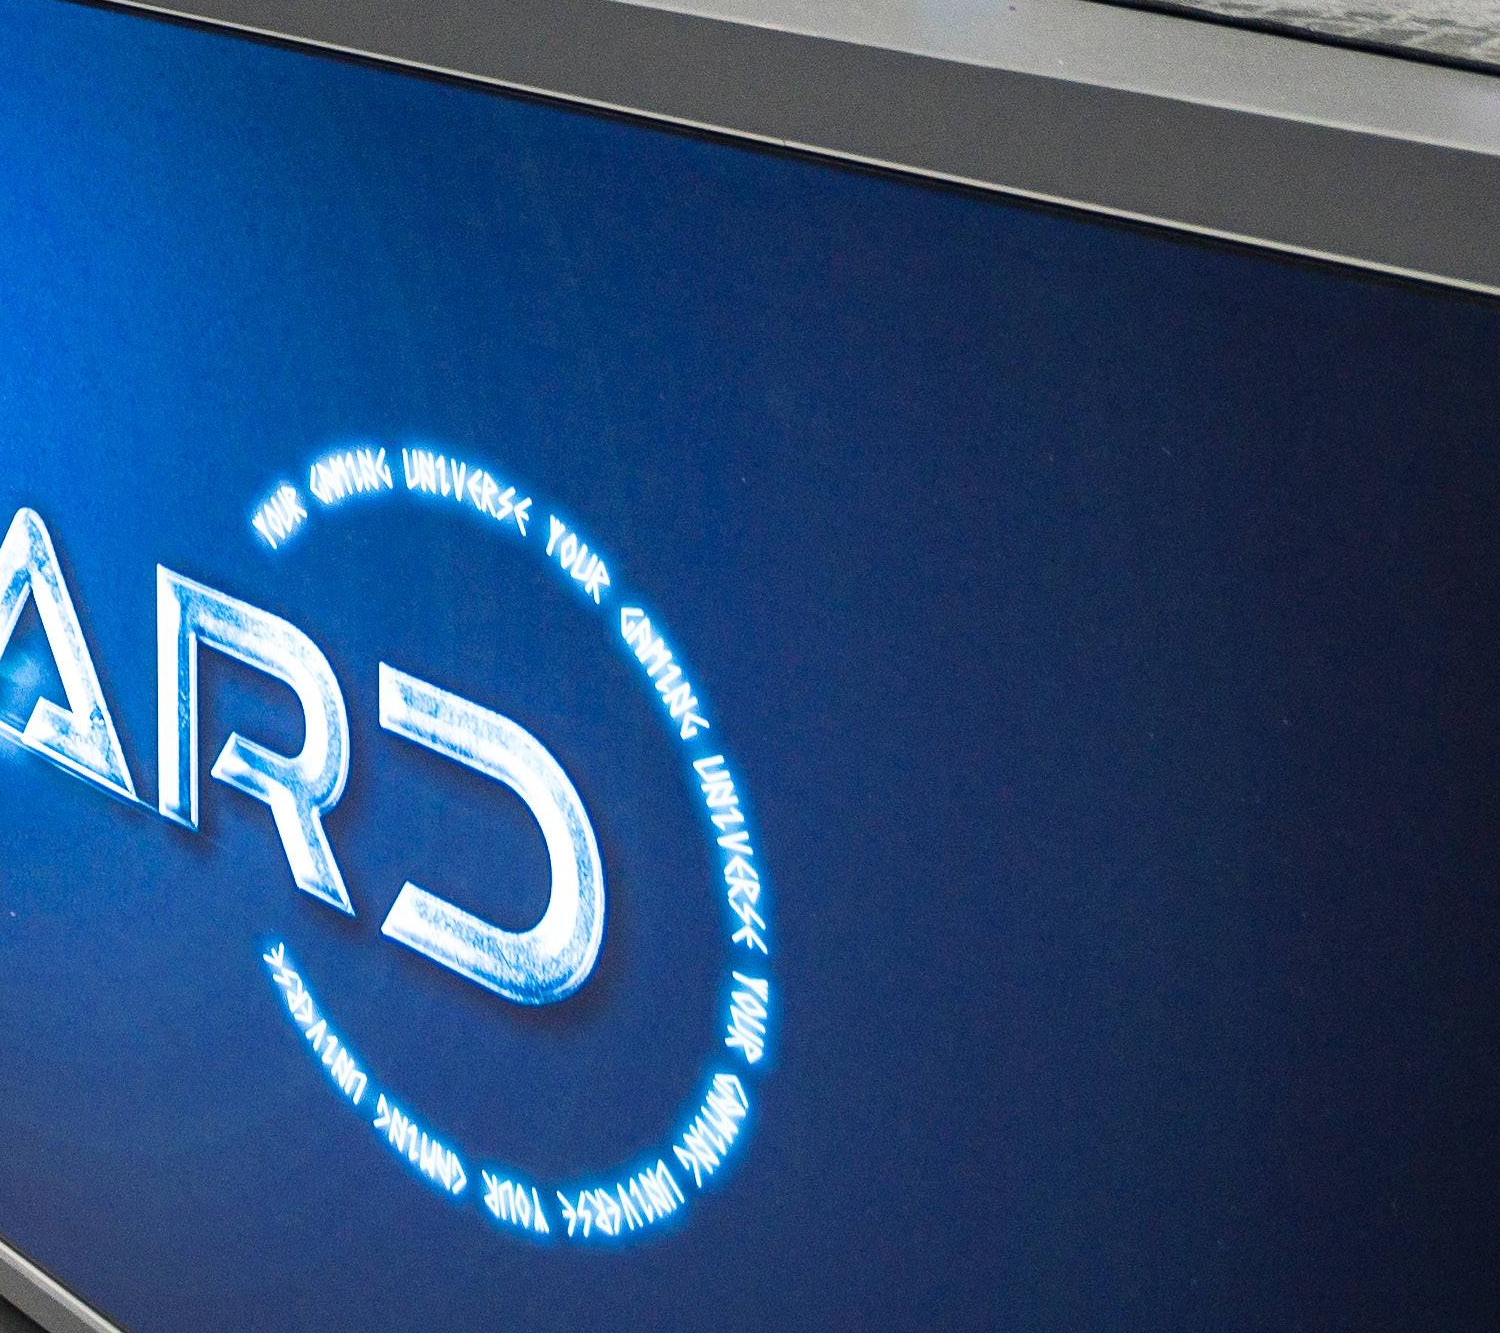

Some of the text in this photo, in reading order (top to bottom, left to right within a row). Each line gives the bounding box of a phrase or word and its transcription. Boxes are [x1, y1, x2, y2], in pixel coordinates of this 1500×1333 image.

[252, 447, 768, 1237] YOUR GAMING UNIVERSE YOUR GAMING UNIVERSE YOUR GAMING UNIVERSE YOUR GAMING UNIVERSE
